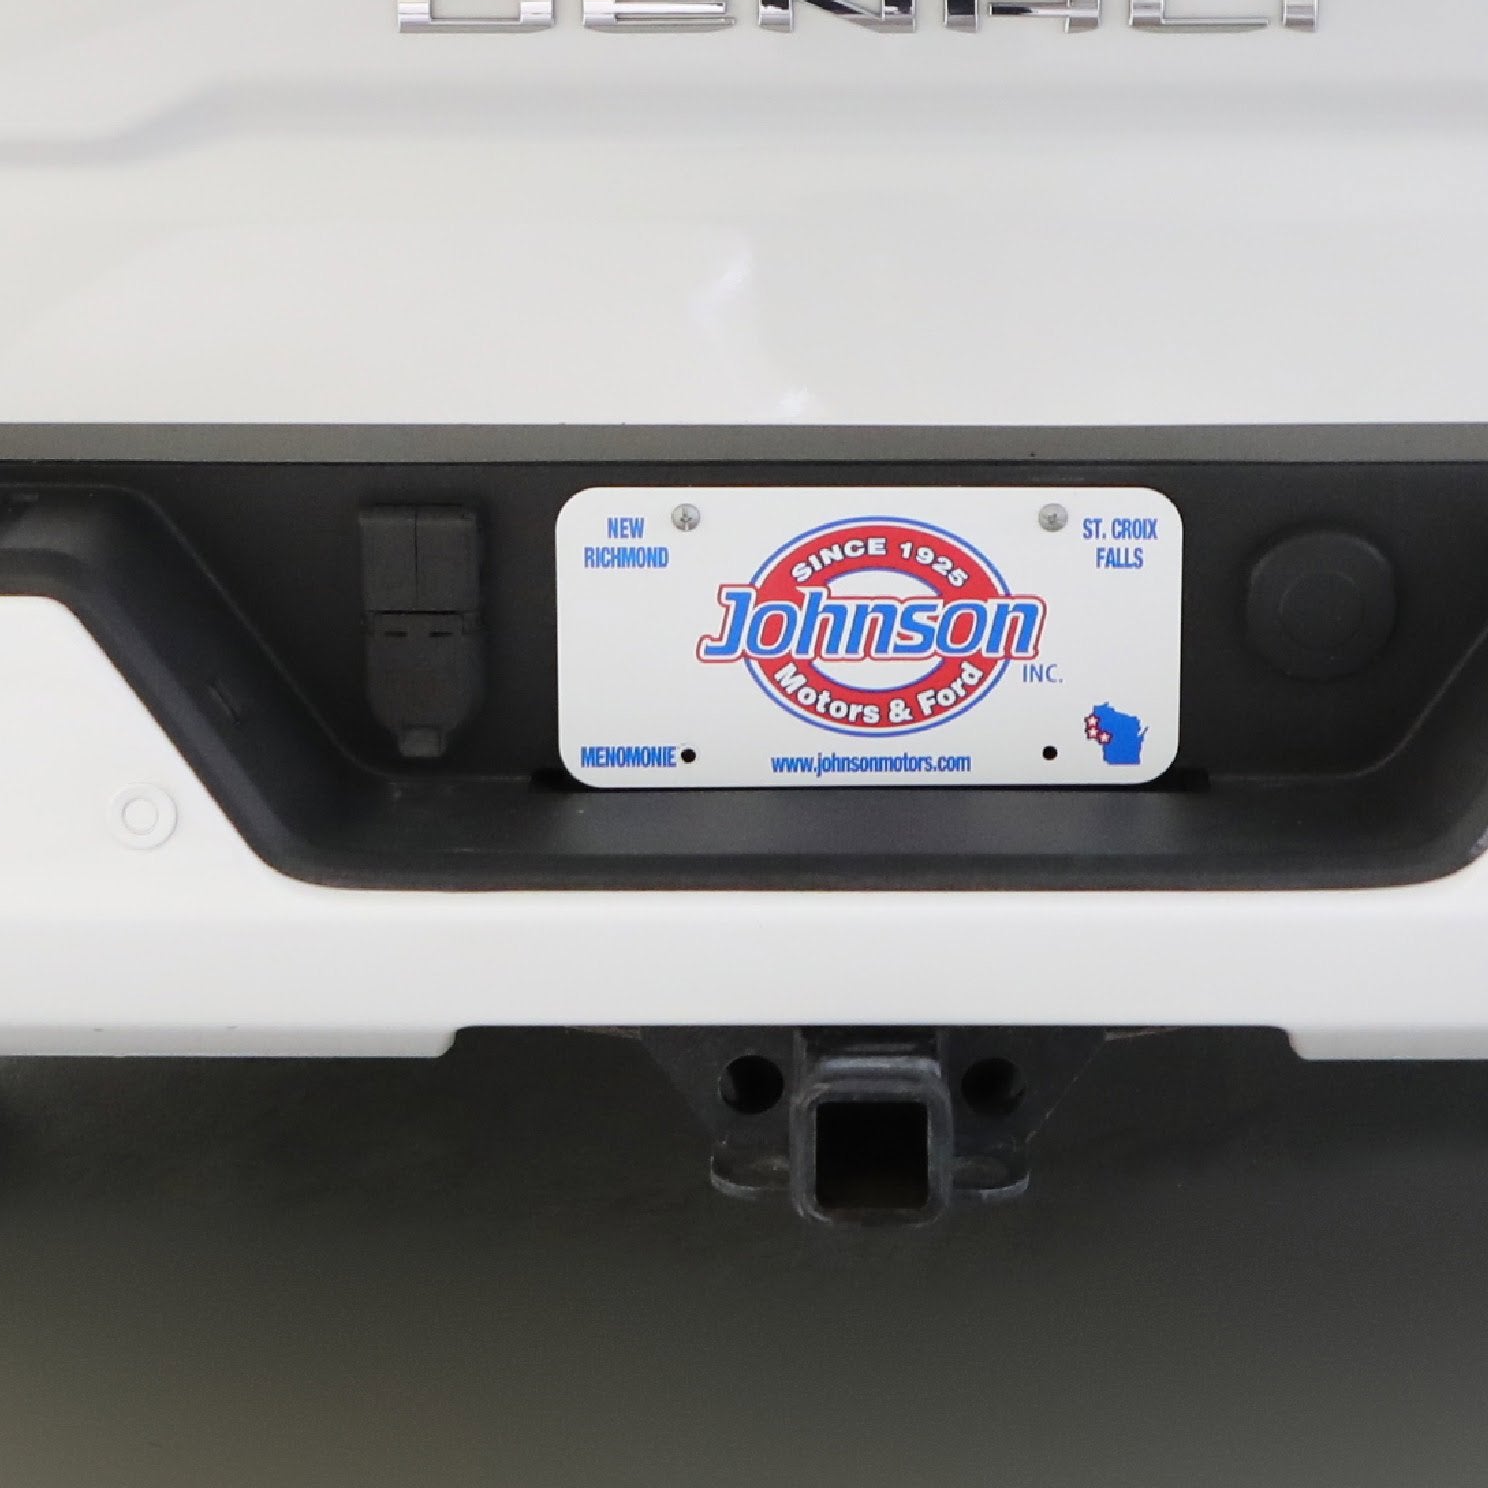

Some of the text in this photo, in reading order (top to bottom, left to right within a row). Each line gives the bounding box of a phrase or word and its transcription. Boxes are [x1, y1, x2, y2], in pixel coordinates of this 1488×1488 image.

[607, 517, 645, 539] NEW
[1082, 518, 1159, 541] ST. CROIX
[583, 545, 670, 569] RICHMOND
[790, 537, 967, 589] SINCE 1925
[1096, 546, 1145, 569] FALLS
[702, 585, 1044, 660] Johnson
[1021, 663, 1064, 684] INC.
[774, 661, 984, 724] Motors & Ford
[580, 746, 678, 769] MENOMONIE
[770, 752, 972, 777] www.johnsonmotors.com
